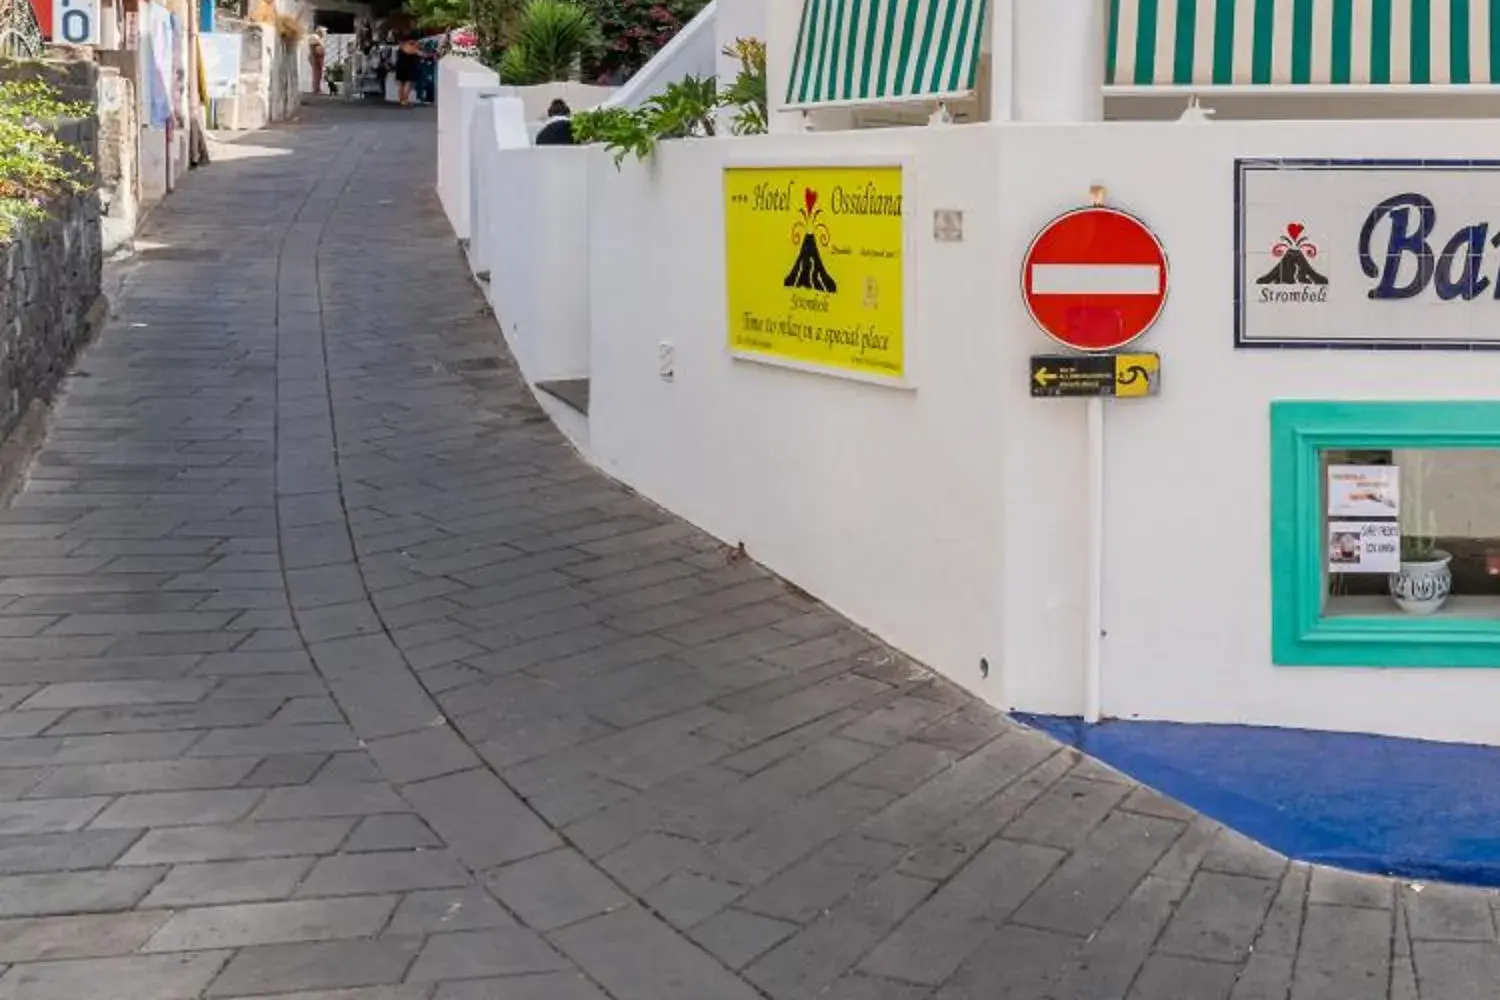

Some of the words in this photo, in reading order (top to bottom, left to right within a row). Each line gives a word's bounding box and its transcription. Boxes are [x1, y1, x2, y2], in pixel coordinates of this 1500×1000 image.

[752, 180, 795, 212] Hotel
[831, 180, 902, 217] Ossidiana
[1259, 285, 1329, 304] Stromboli
